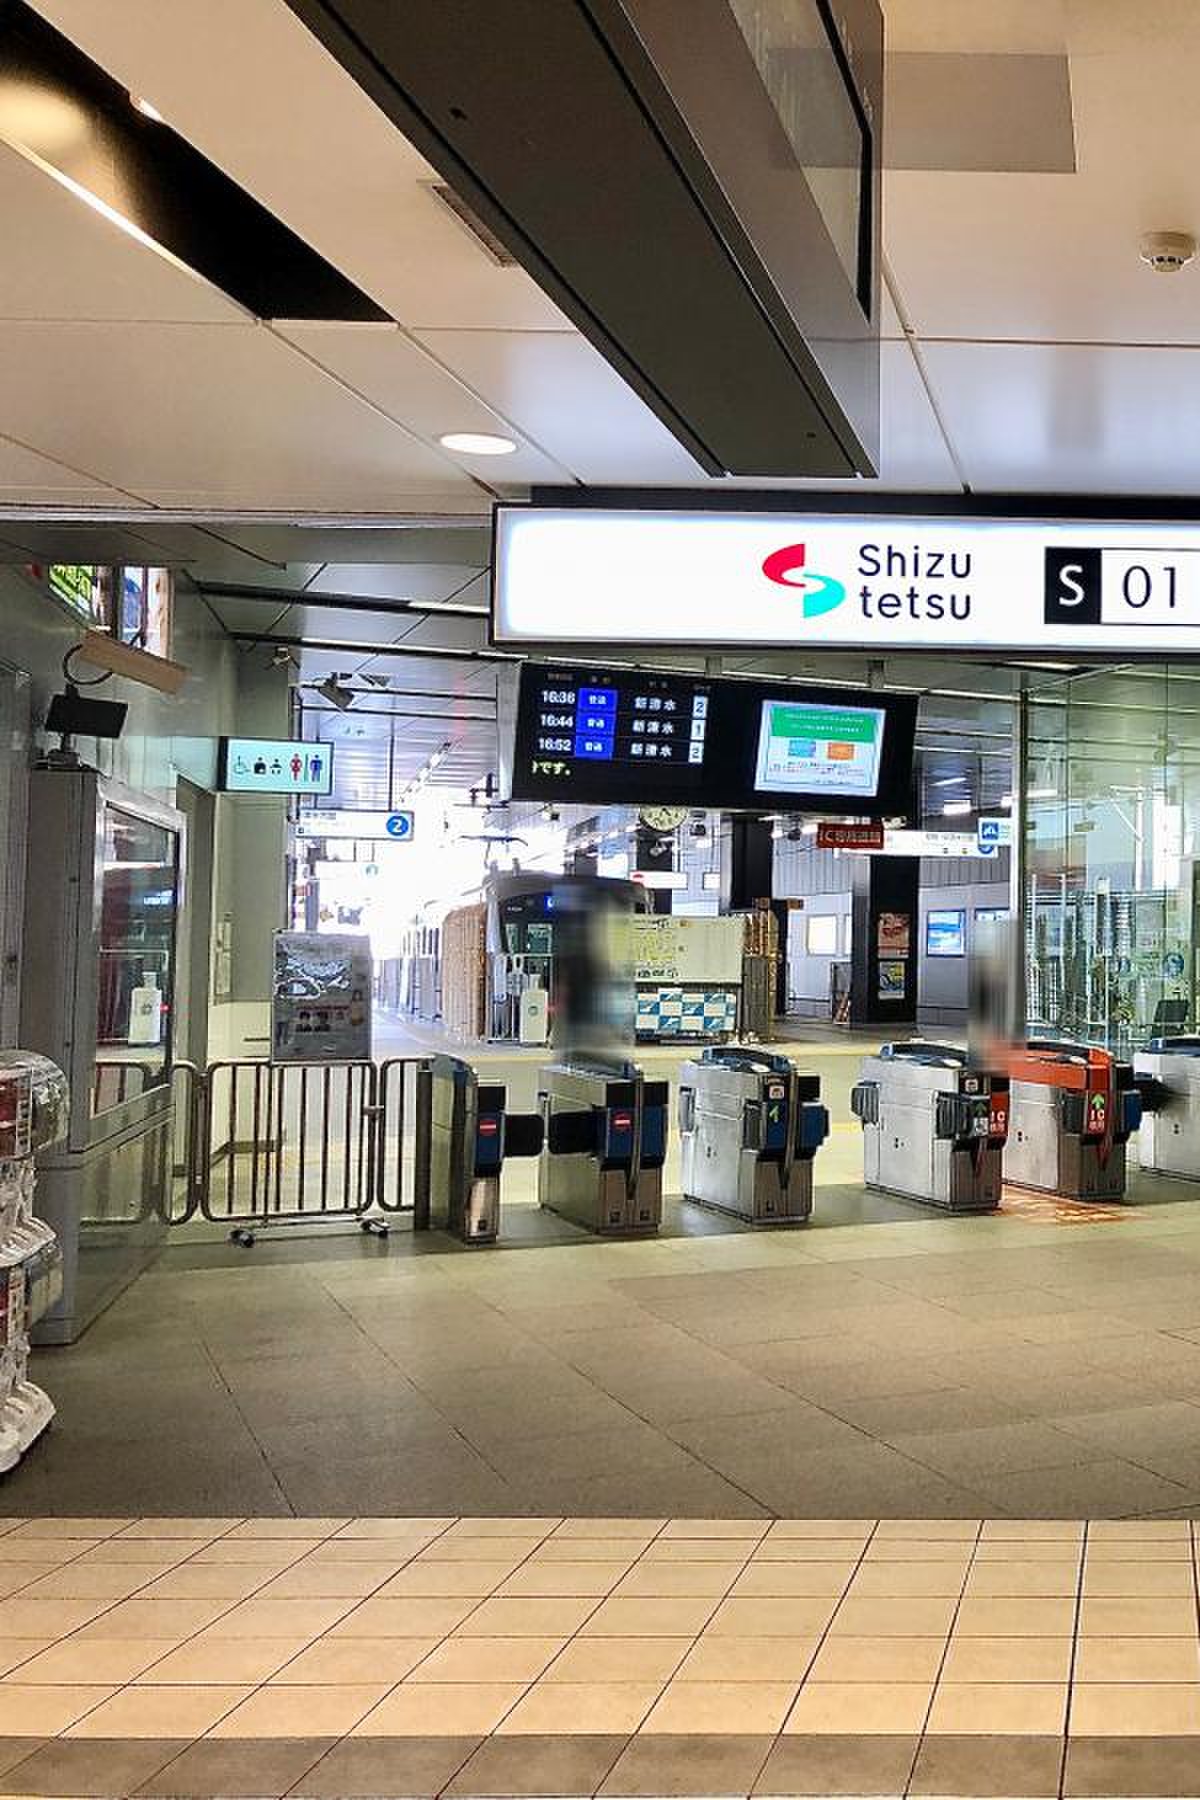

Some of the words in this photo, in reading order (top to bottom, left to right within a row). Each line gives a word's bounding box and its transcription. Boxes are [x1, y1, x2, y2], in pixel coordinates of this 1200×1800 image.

[858, 543, 971, 579] Shizu
[1059, 564, 1085, 606] S
[1123, 565, 1176, 609] 01
[859, 585, 971, 621] tetsu
[540, 714, 574, 728] 16:44
[538, 738, 572, 752] 16:52
[391, 818, 402, 833] 2
